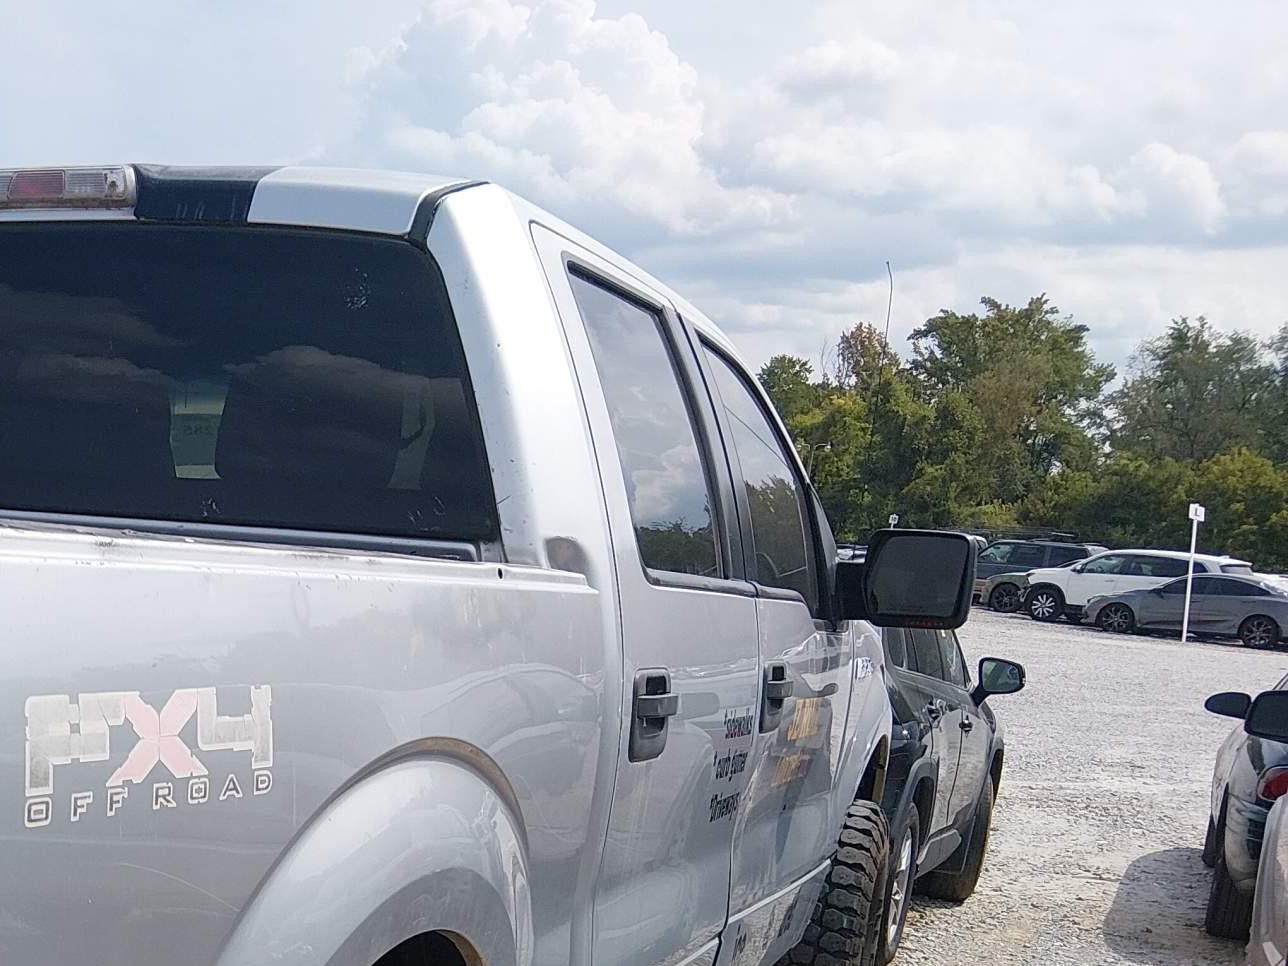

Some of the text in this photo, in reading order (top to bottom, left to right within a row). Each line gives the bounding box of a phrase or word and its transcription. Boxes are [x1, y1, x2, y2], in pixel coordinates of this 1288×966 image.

[25, 685, 273, 796] FX4
[25, 770, 273, 827] OFF ROAD
